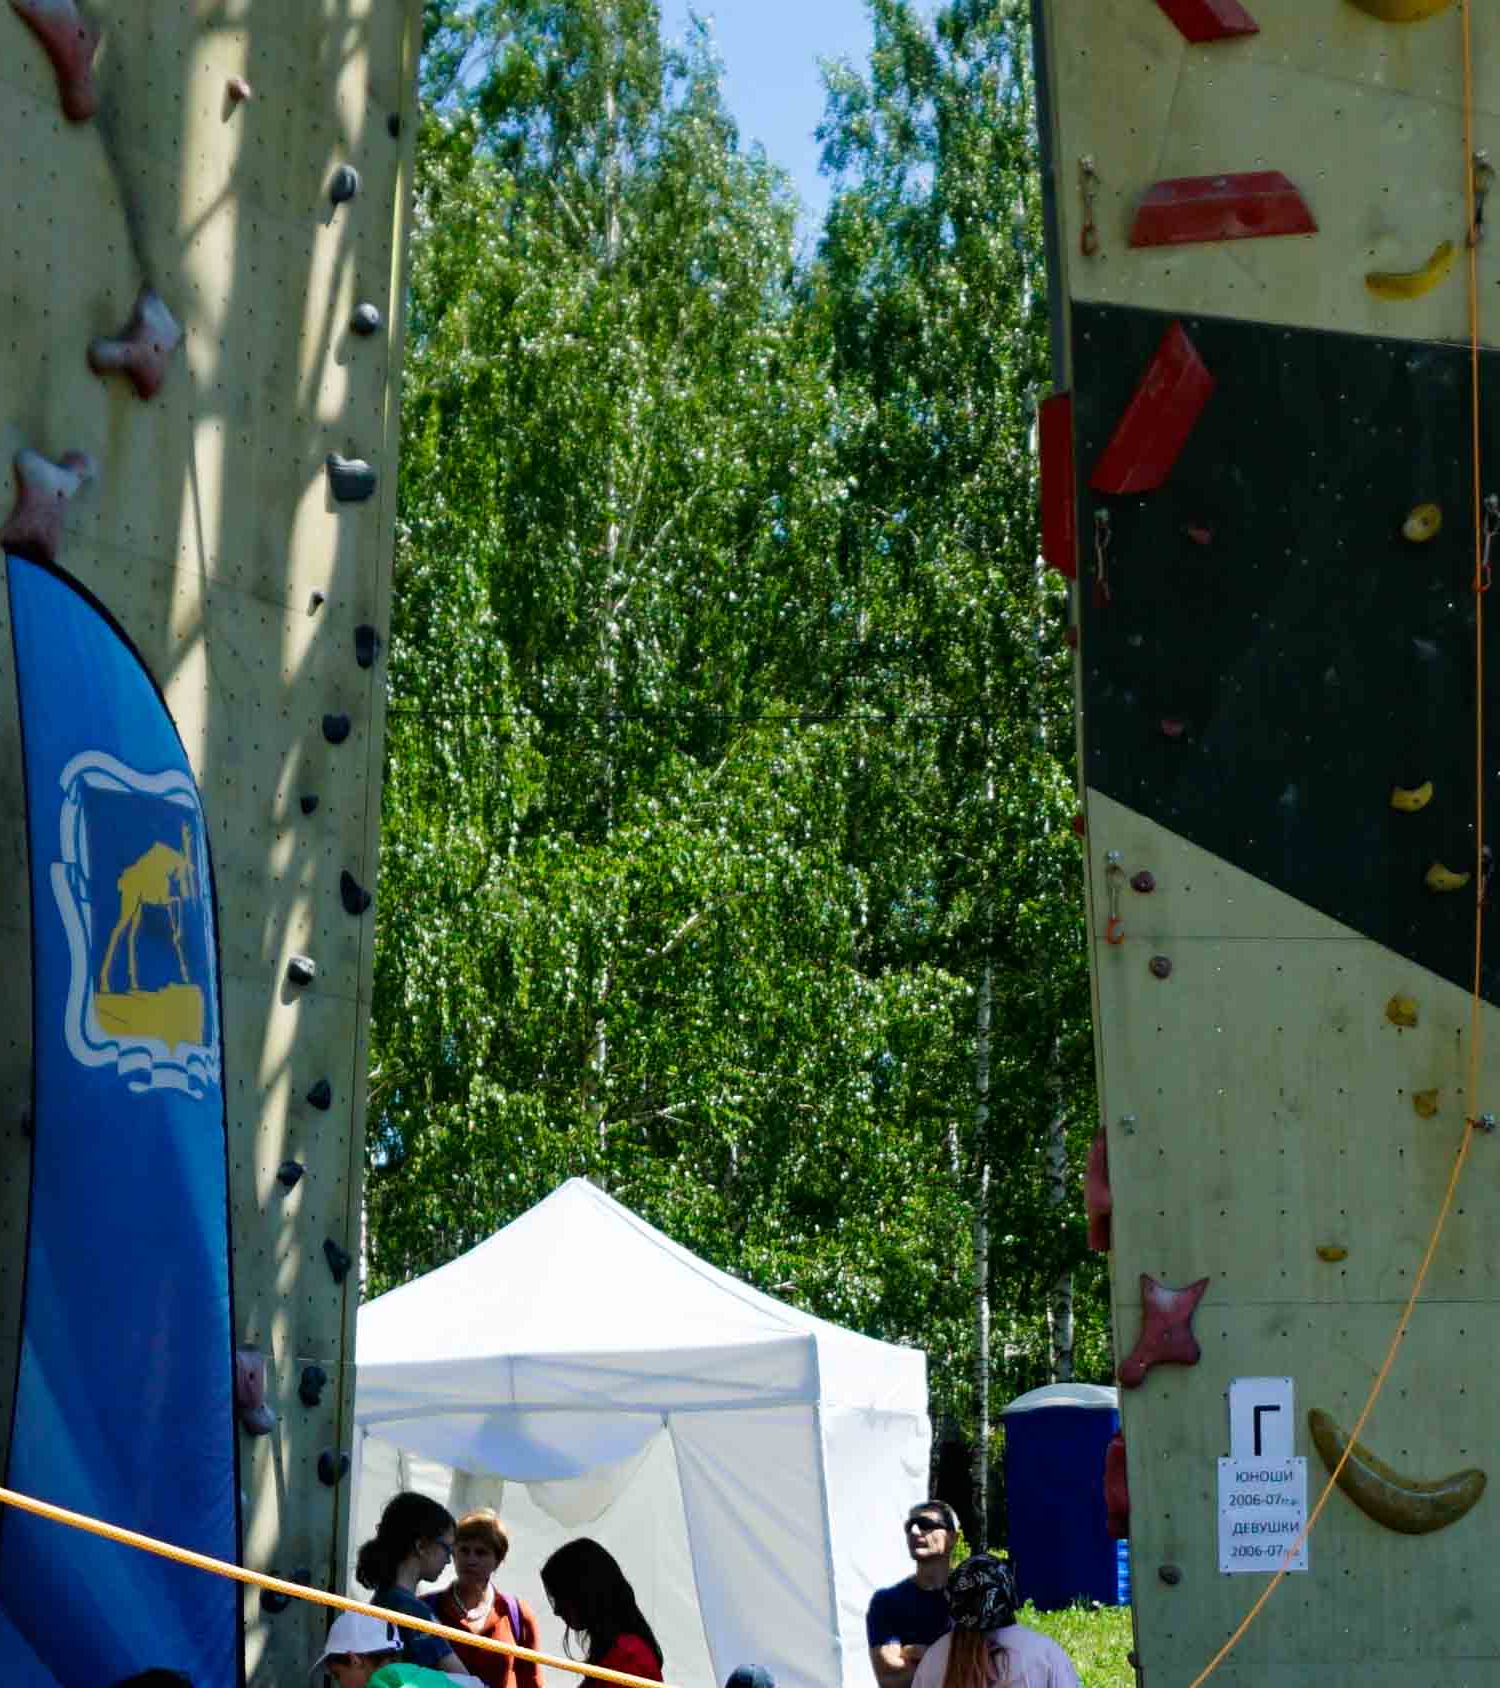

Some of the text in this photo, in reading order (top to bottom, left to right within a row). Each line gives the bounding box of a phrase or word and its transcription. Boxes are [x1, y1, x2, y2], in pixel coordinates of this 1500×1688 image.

[1253, 1405, 1281, 1456] Г
[1235, 1470, 1293, 1483] ЮНОШИ
[1232, 1520, 1300, 1536] ДЕВУШКИ
